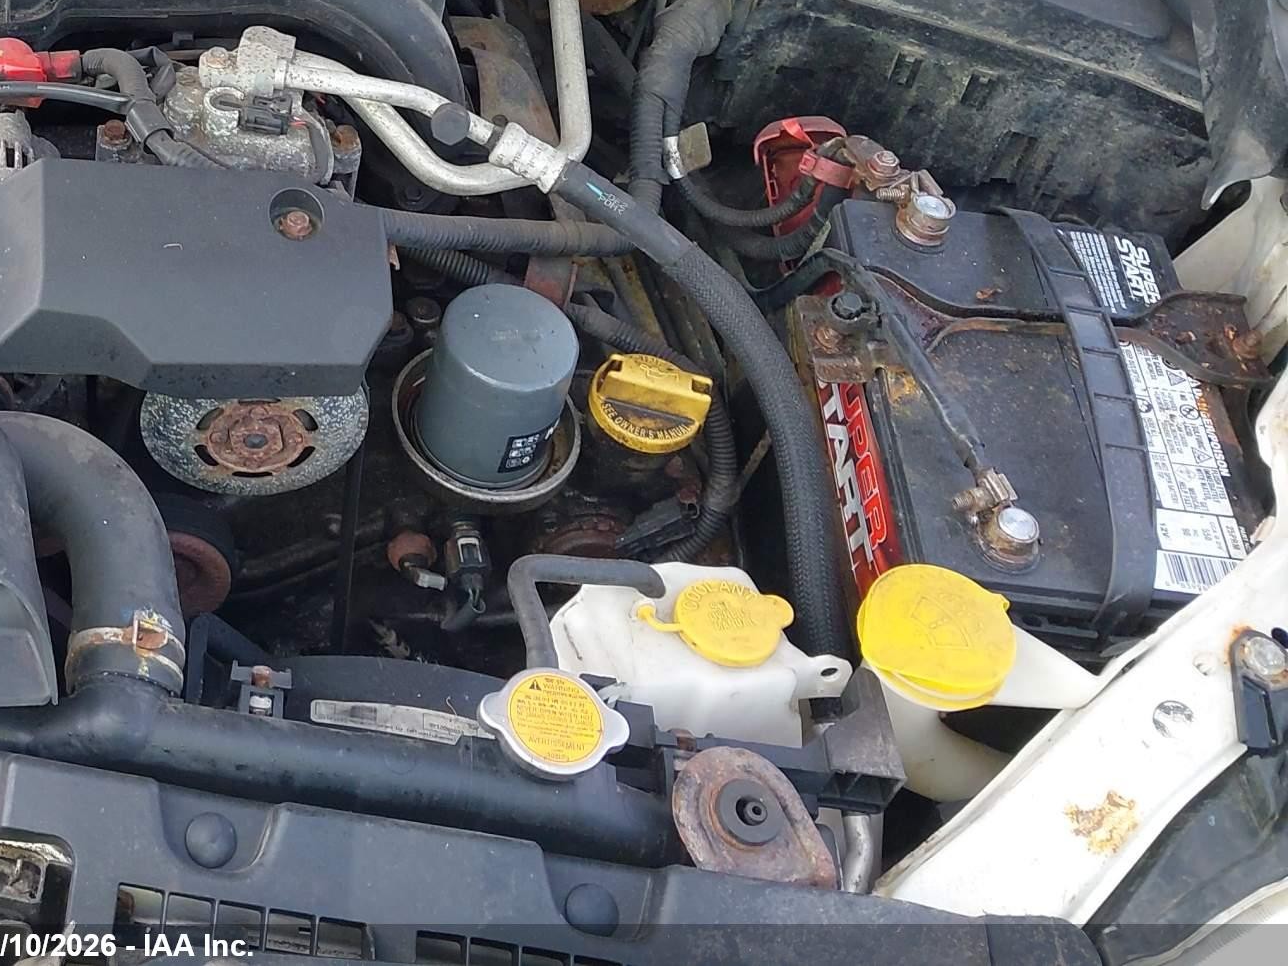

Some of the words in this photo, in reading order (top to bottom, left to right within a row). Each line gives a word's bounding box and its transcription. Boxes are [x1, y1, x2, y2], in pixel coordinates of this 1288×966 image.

[1114, 235, 1151, 308] START
[1136, 246, 1161, 304] SUPER
[602, 403, 618, 420] SEE
[614, 416, 656, 440] OWNER'S
[656, 424, 691, 441] MANUAL
[817, 380, 875, 563] TART
[840, 381, 888, 552] UPER
[1159, 522, 1171, 539] 12V
[681, 580, 759, 611] COOLANT
